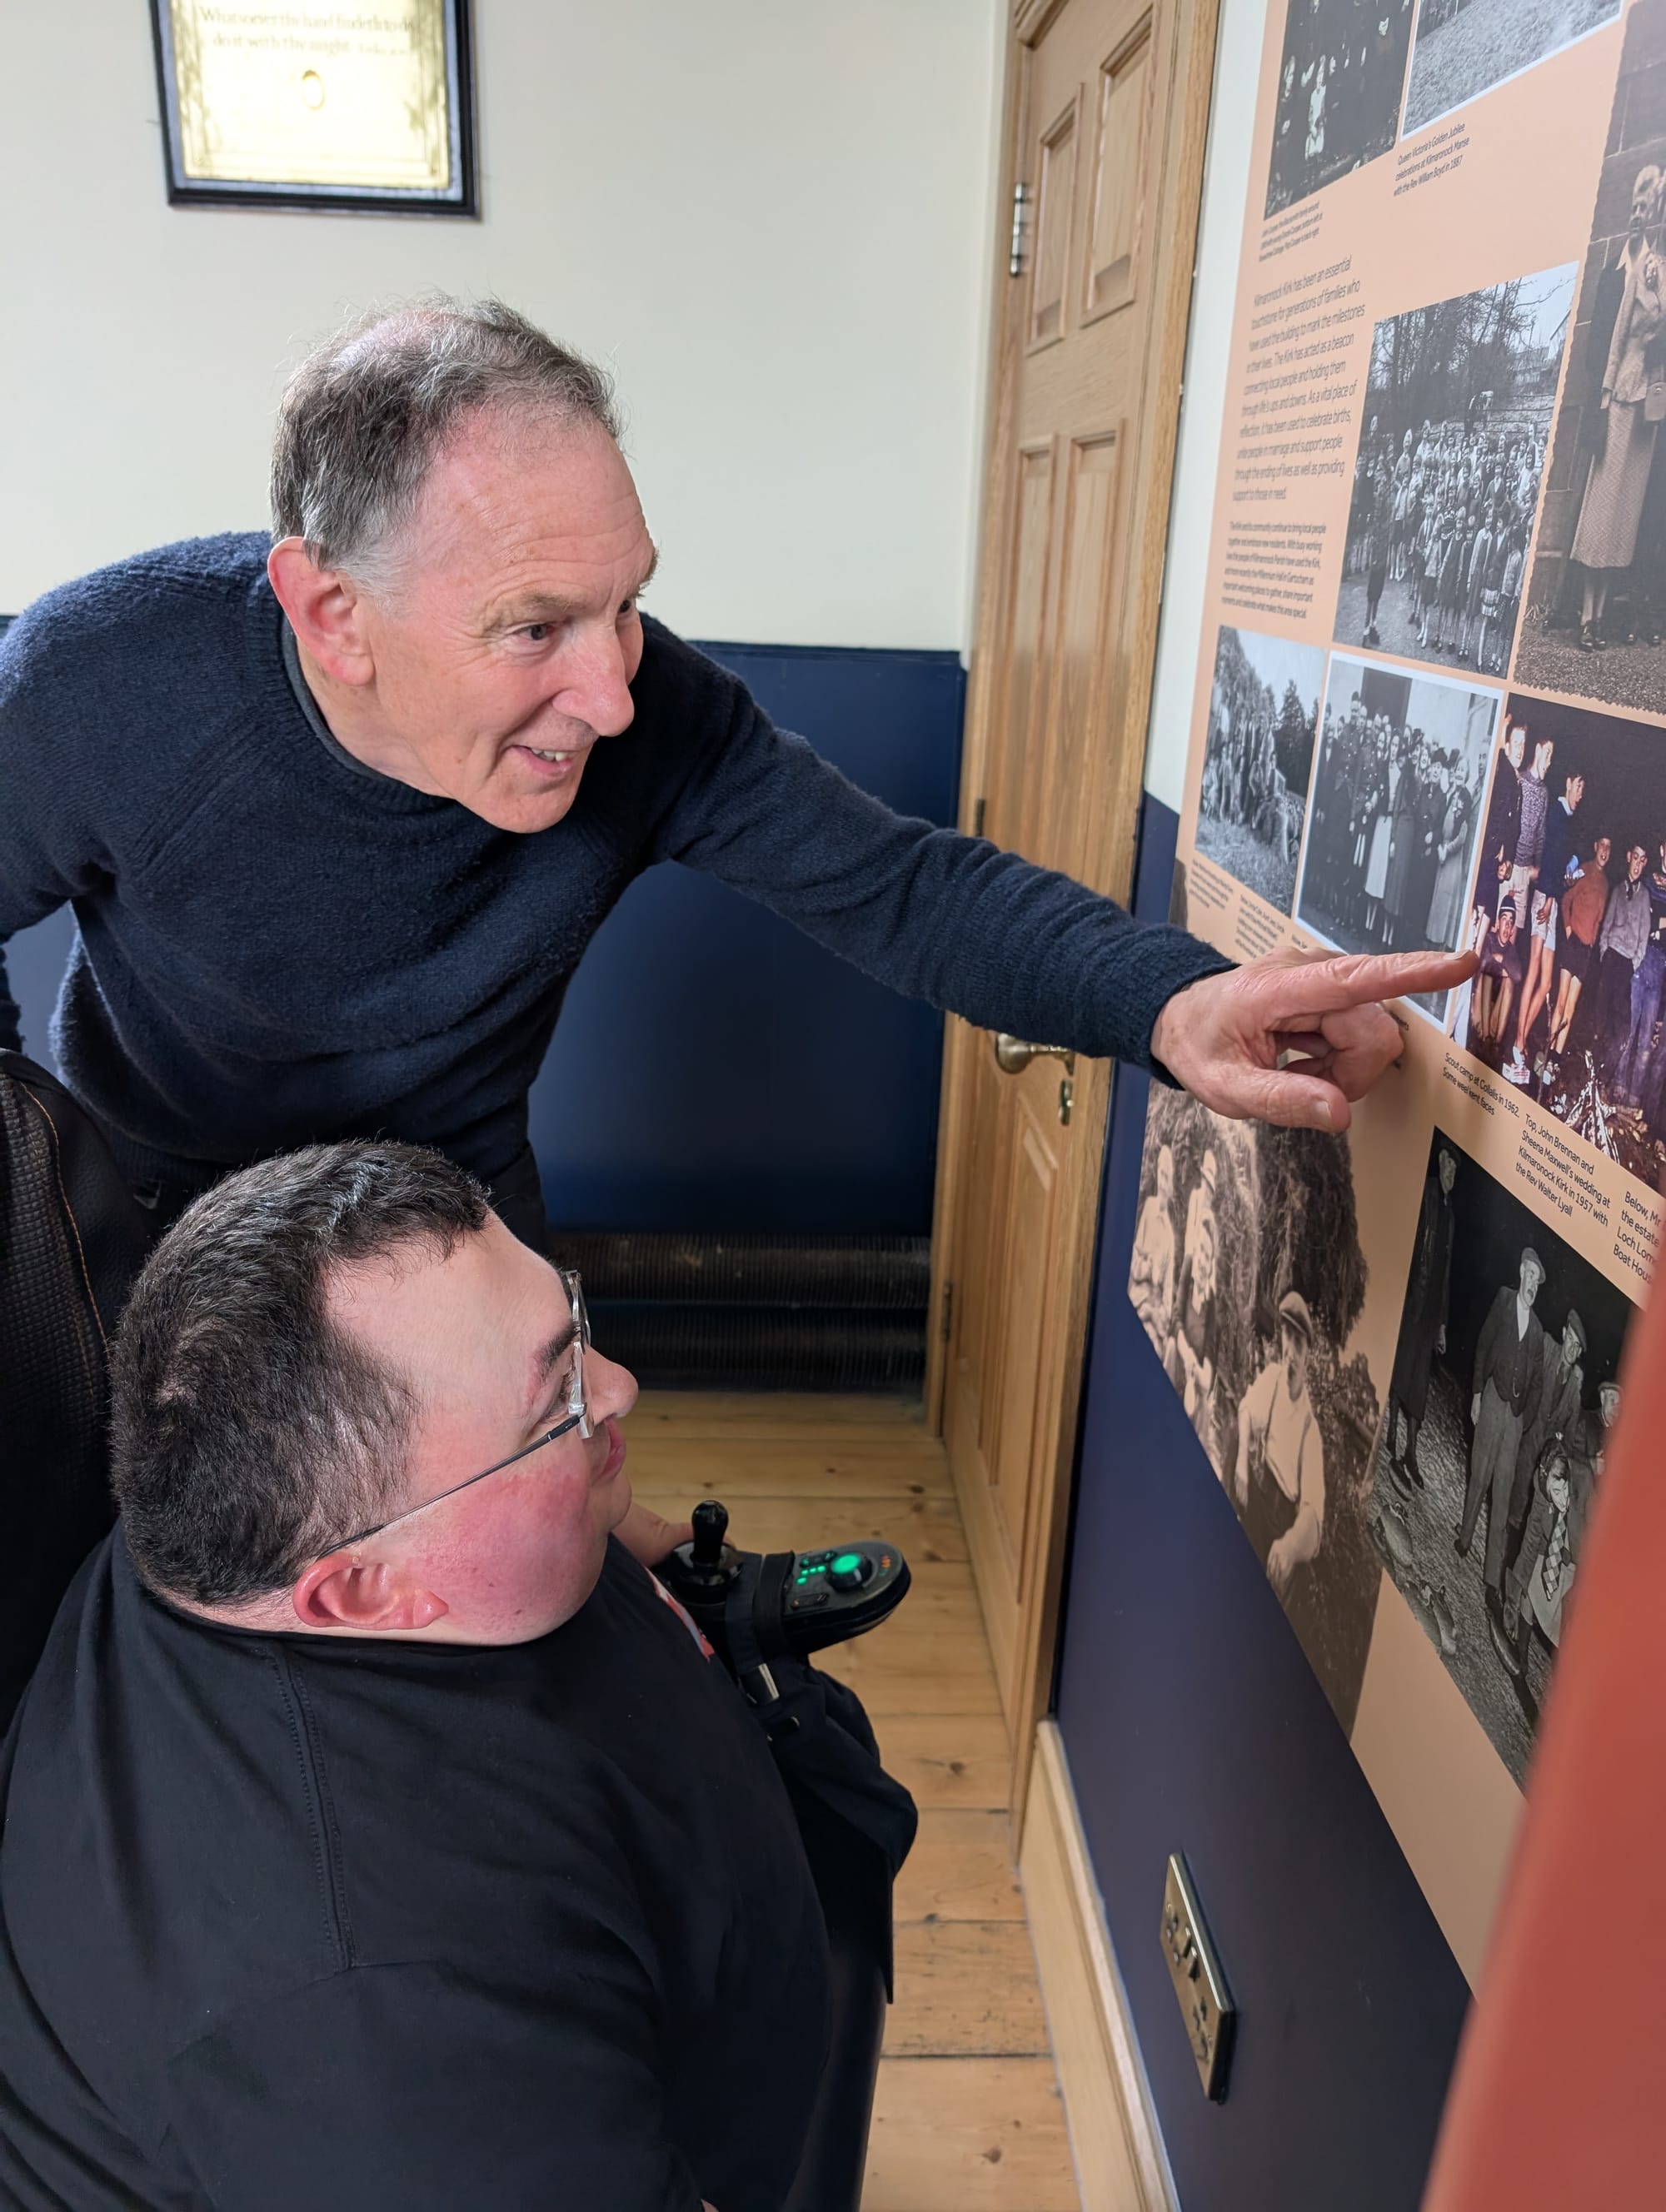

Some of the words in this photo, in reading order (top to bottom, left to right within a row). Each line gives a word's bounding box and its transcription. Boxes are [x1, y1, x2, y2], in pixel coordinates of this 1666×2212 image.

[1396, 163, 1421, 180] celebrations
[1421, 159, 1426, 168] at
[1426, 144, 1453, 165] Kilmaronock
[1454, 138, 1470, 152] Manse
[1398, 152, 1412, 165] Queen
[1412, 140, 1432, 158] Victoria's
[1432, 133, 1448, 147] Golden
[1448, 124, 1466, 139] Jubilee
[1394, 184, 1402, 196] with
[1419, 171, 1433, 184] William
[1434, 162, 1445, 177] Boyd
[1445, 161, 1450, 171] in
[1451, 153, 1463, 169] 1887
[1443, 1067, 1457, 1085] Some
[1457, 1081, 1469, 1094] weel
[1469, 1088, 1480, 1104] kent
[1480, 1097, 1494, 1115] faces
[1445, 1053, 1459, 1070] Scout
[1459, 1066, 1473, 1081] camp
[1474, 1076, 1479, 1086] at
[1499, 1094, 1504, 1105] in
[1504, 1099, 1519, 1118] 1962.
[1525, 1113, 1537, 1133] Top,
[1538, 1126, 1554, 1143] John
[1554, 1137, 1580, 1165] Brennan
[1581, 1160, 1594, 1175] and
[1516, 1162, 1526, 1177] the
[1526, 1170, 1538, 1186] Rev
[1538, 1179, 1558, 1204] Walter
[1558, 1197, 1573, 1217] Lyall
[1519, 1146, 1554, 1182] Kilmaronock
[1556, 1176, 1568, 1194] Kirk
[1569, 1186, 1575, 1200] in
[1576, 1193, 1593, 1213] 1957
[1593, 1208, 1609, 1228] with
[1522, 1130, 1544, 1154] Sheena
[1544, 1148, 1573, 1178] Maxwell's
[1574, 1173, 1602, 1204] wedding
[1603, 1197, 1611, 1208] at
[1621, 1209, 1634, 1227] the
[1634, 1222, 1659, 1248] estate
[1624, 1191, 1649, 1220] Below,
[1649, 1211, 1662, 1227] Mr
[1614, 1244, 1631, 1267] Boat
[1632, 1259, 1652, 1283] Hous
[1617, 1226, 1636, 1250] Loch
[1636, 1242, 1654, 1264] Lom
